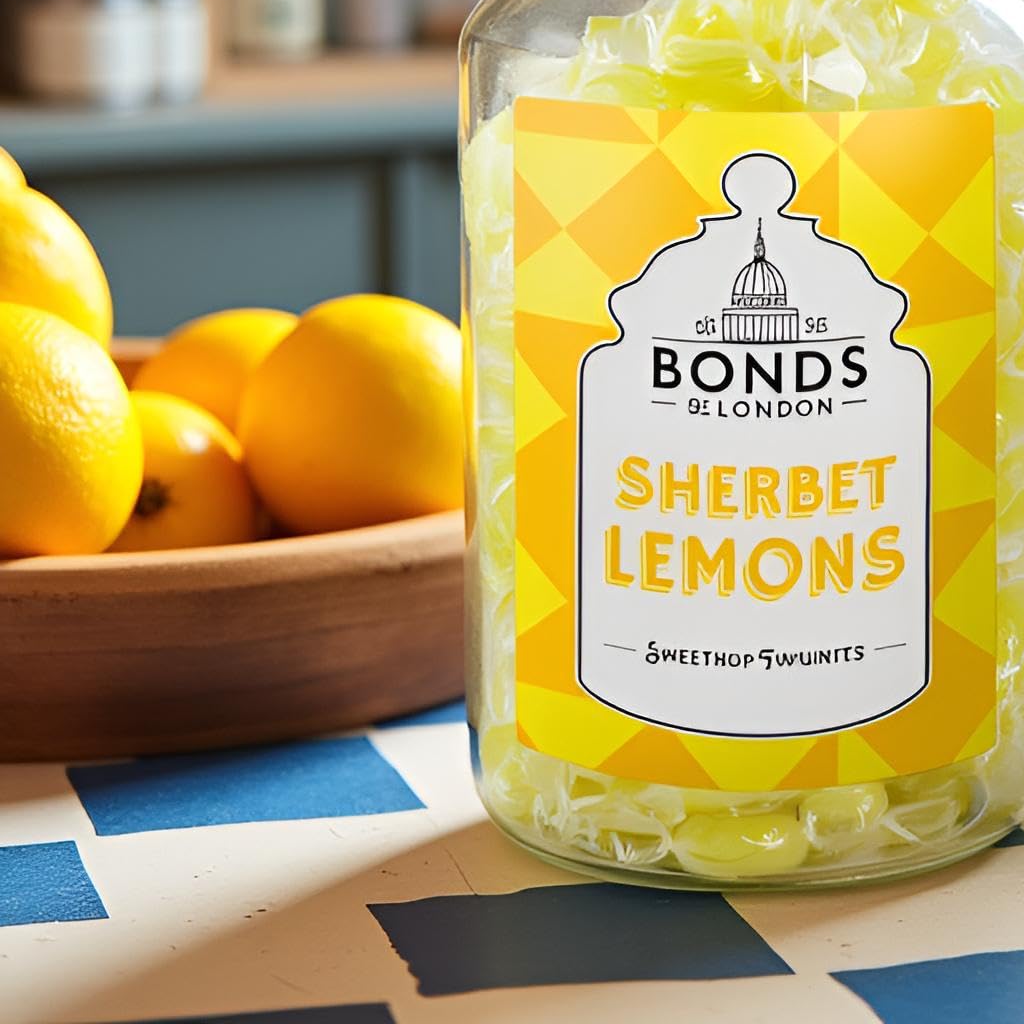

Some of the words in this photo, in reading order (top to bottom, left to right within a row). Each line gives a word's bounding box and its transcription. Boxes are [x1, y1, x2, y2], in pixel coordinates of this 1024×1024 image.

[653, 346, 868, 394] BONDS
[717, 397, 833, 418] LONDON
[614, 455, 898, 519] SHERBET
[604, 525, 906, 602] LEMONS
